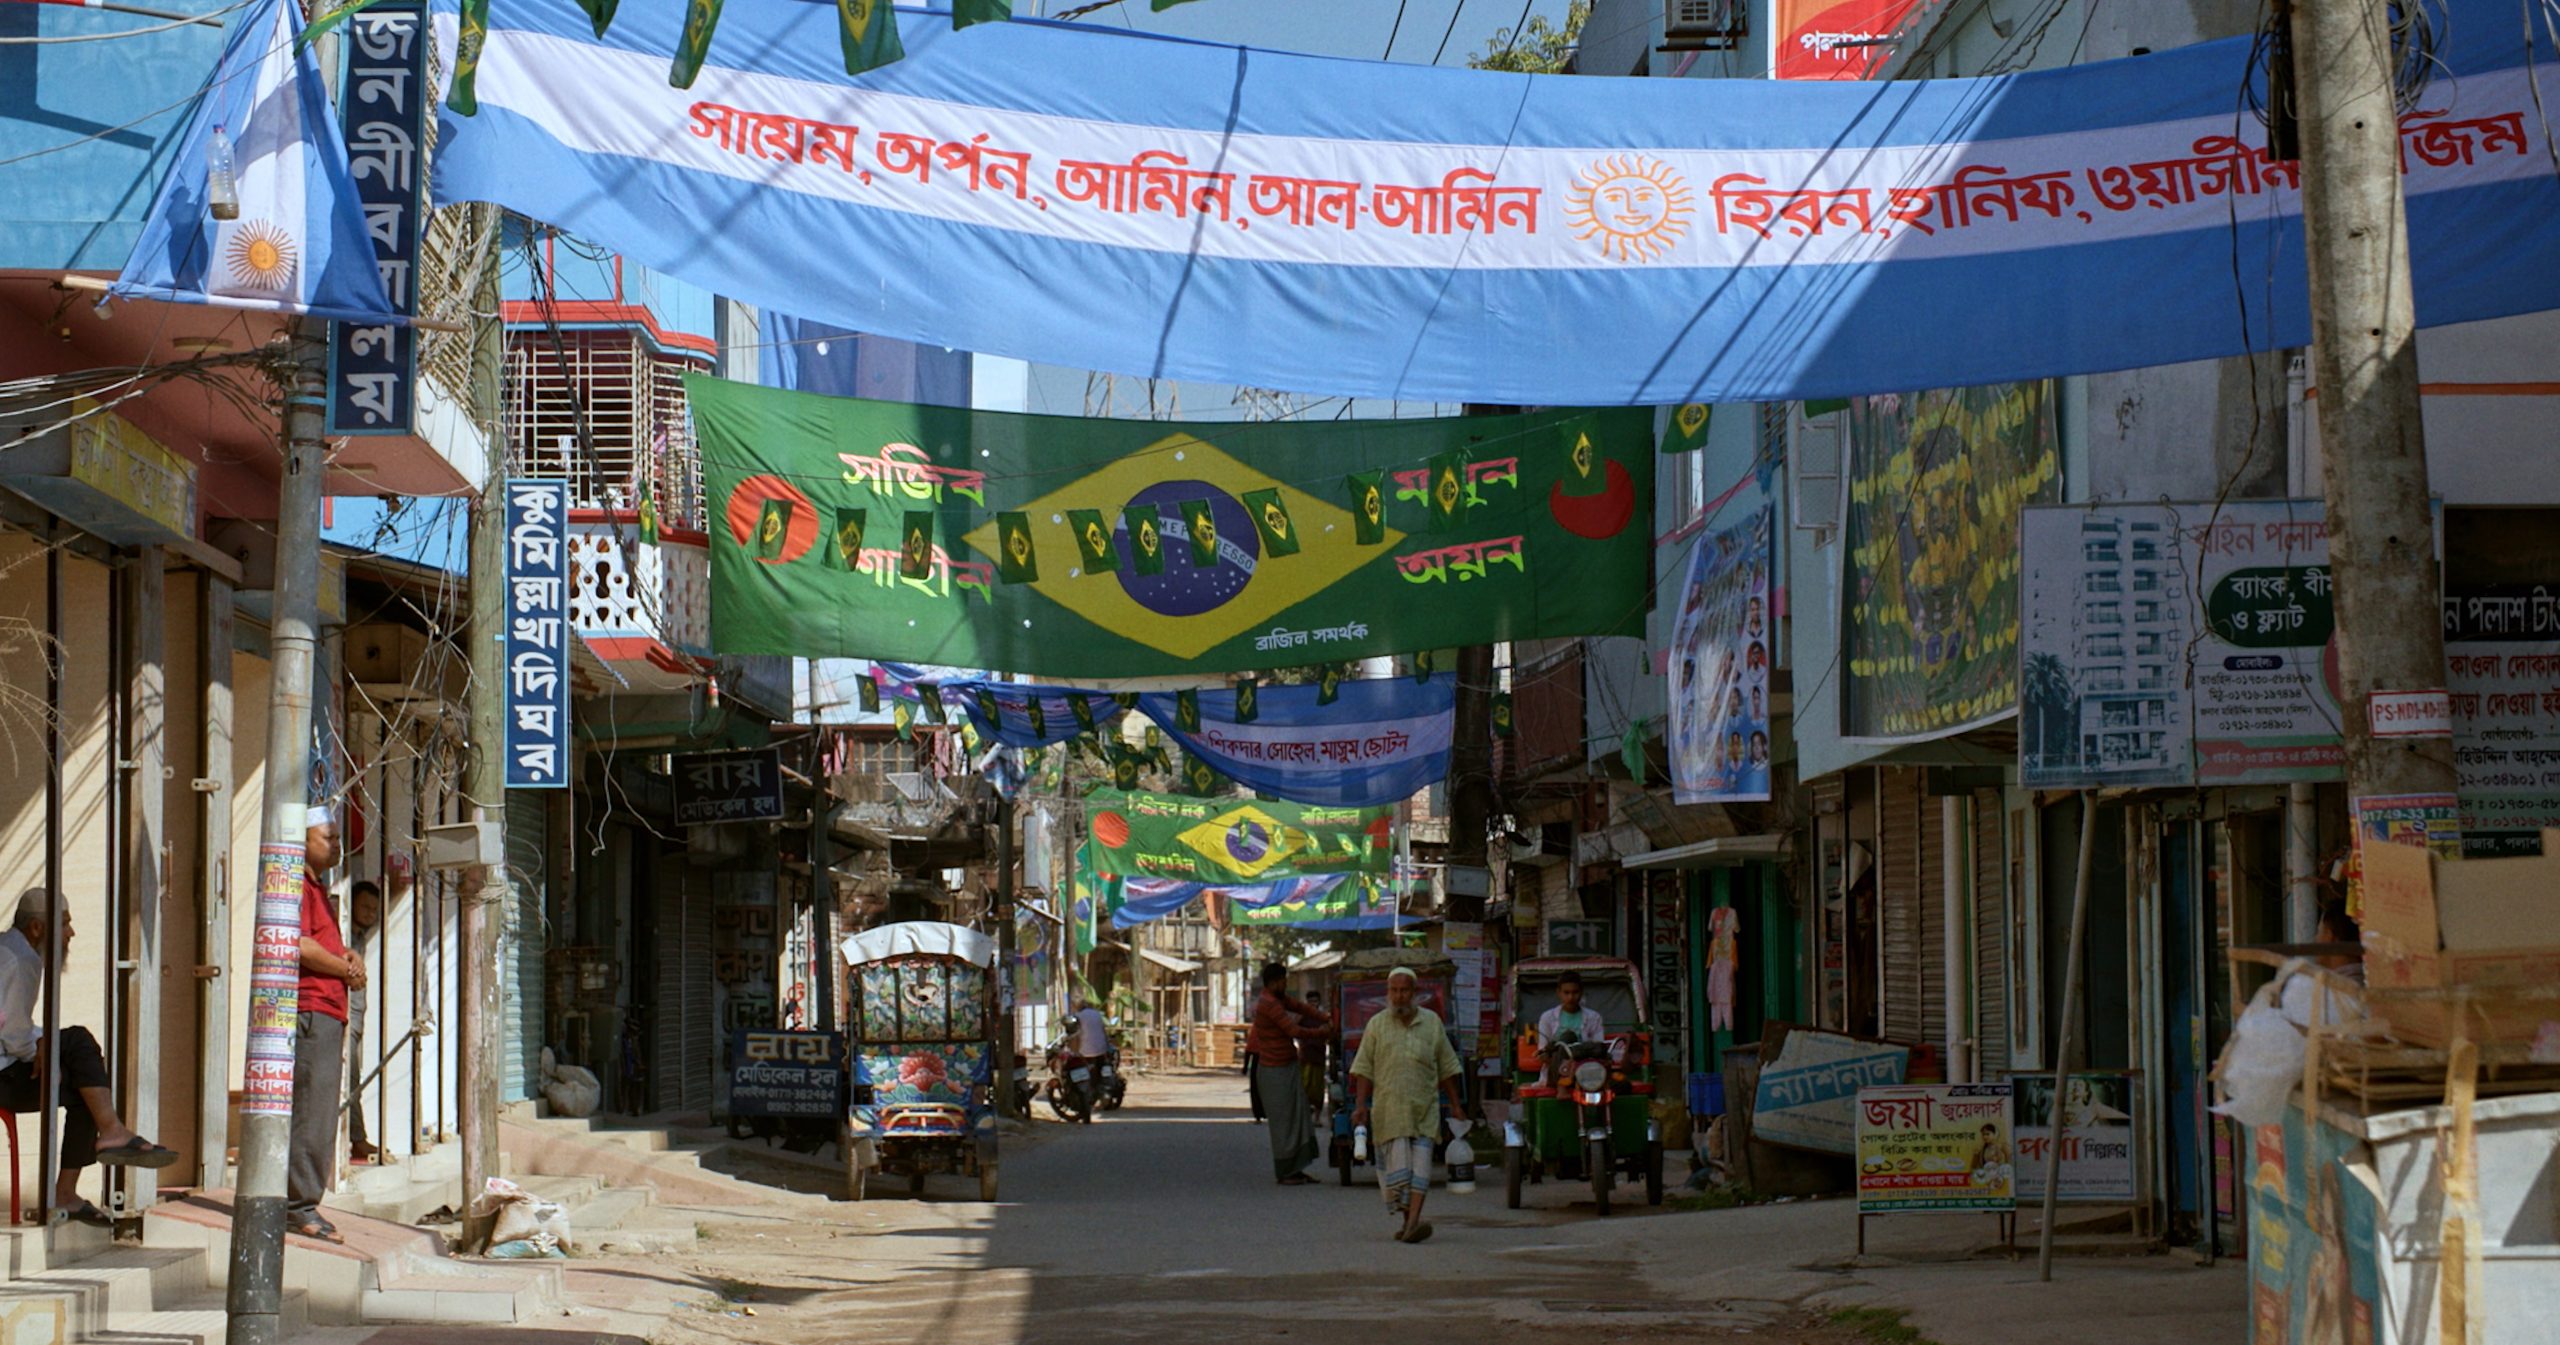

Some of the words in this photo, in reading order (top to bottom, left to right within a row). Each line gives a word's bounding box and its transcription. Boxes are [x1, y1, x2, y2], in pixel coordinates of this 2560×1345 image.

[1394, 535, 1525, 584] অয়ন
[2232, 611, 2250, 630] ও
[2468, 596, 2527, 633] পলাশ
[1312, 620, 1369, 644] সমর্থক
[684, 757, 766, 791] রায়
[751, 796, 776, 816] হল
[745, 1032, 832, 1065] রায়
[735, 1061, 806, 1084] মেডিকেল
[809, 1067, 838, 1088] হল
[1861, 1094, 1937, 1130] জয়া
